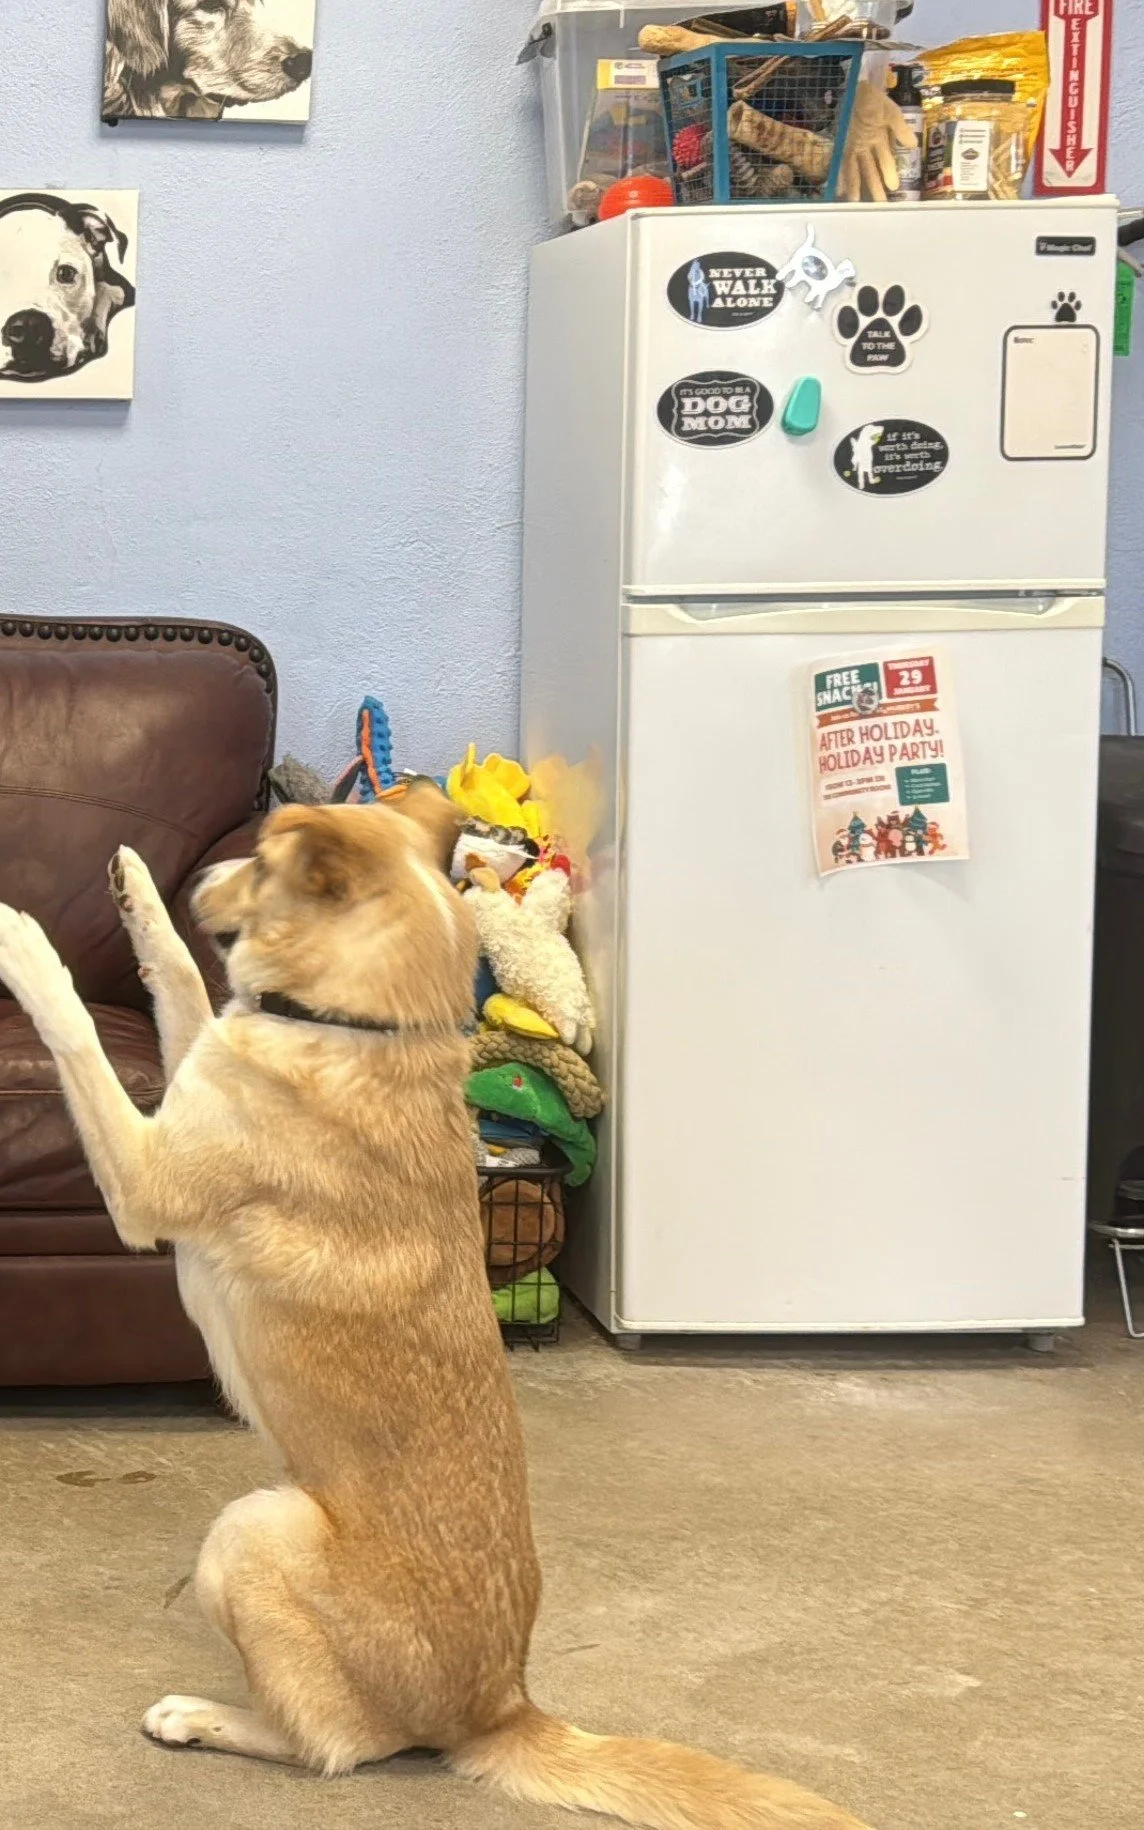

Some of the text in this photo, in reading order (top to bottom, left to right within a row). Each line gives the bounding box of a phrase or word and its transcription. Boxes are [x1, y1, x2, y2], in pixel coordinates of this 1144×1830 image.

[1059, 0, 1095, 15] FIRE
[1065, 18, 1081, 172] EXTINGUISHER
[708, 267, 767, 278] NEVER
[712, 279, 777, 295] WALK
[711, 296, 774, 308] ALONE
[867, 330, 891, 338] TALK
[861, 342, 896, 350] TO THE
[694, 387, 722, 395] GOOD
[722, 386, 734, 394] TO
[744, 386, 752, 394] A
[680, 395, 752, 415] DOG
[681, 415, 752, 431] MOM
[886, 431, 921, 442] if it's
[878, 442, 909, 452] worth
[884, 451, 932, 461] it's worth
[826, 669, 861, 689] FREE
[899, 669, 923, 686] 29
[819, 728, 856, 751] AFTER
[819, 738, 944, 774] HOLIDAY PARTY!
